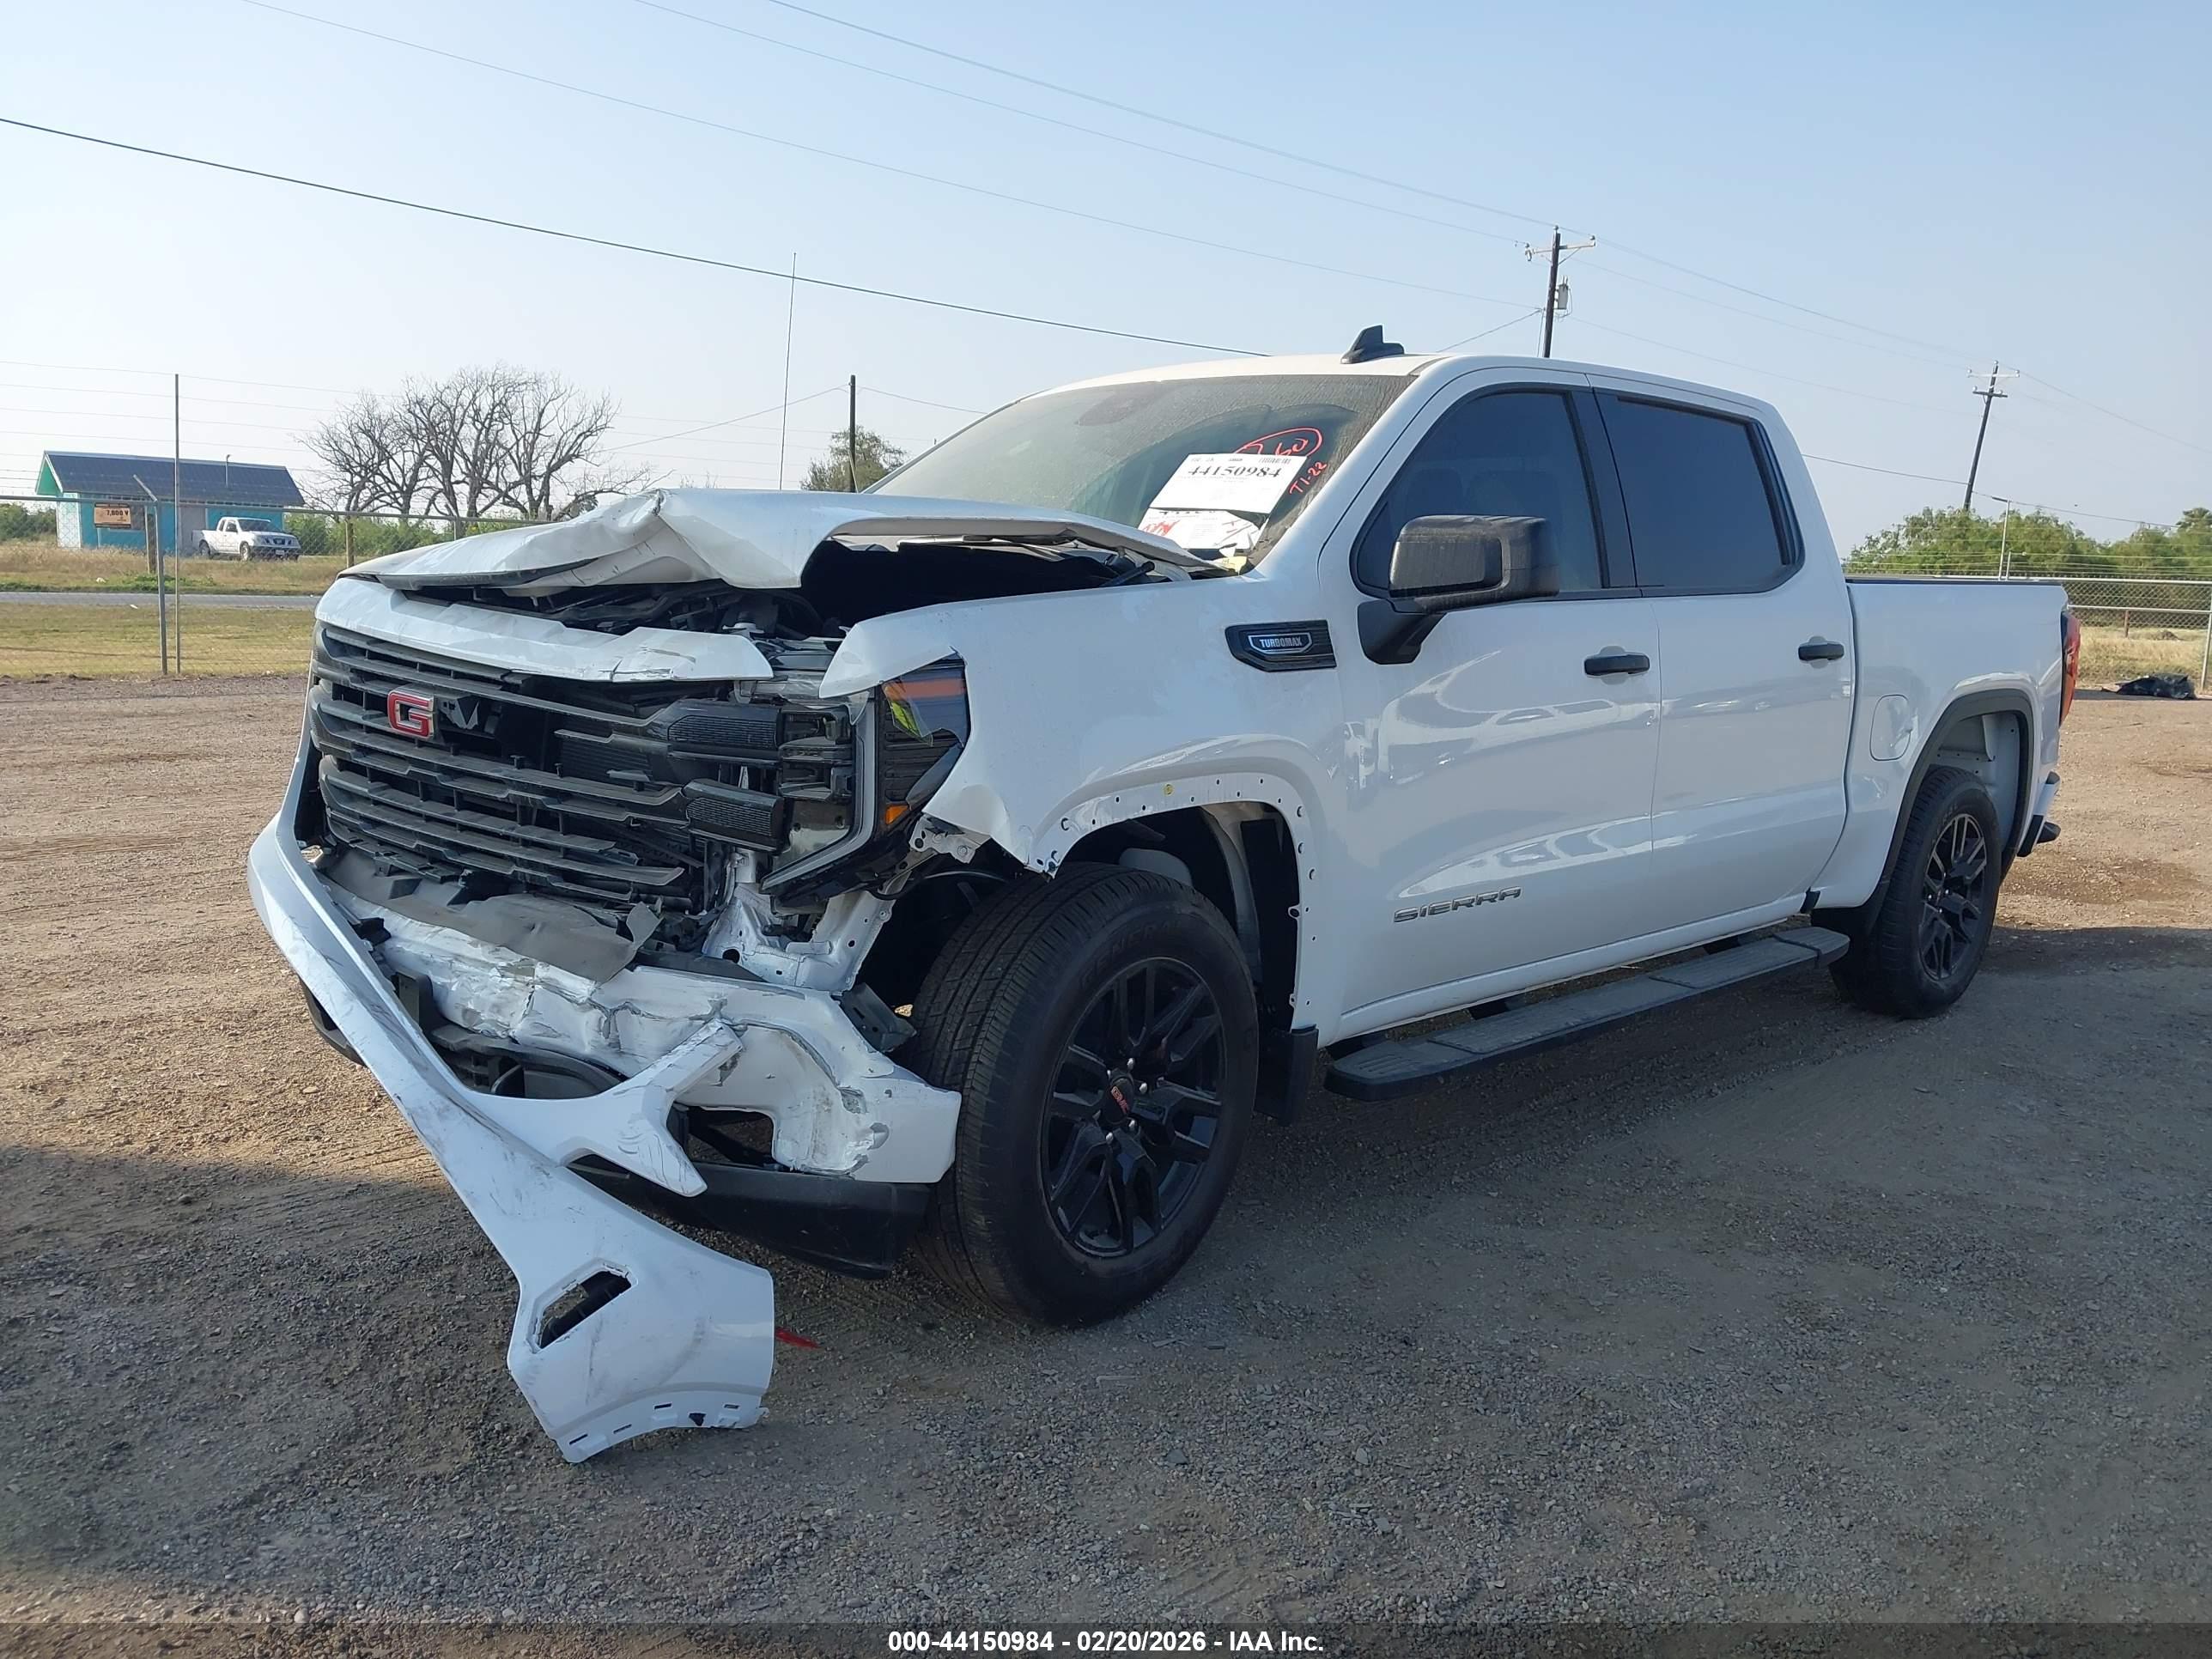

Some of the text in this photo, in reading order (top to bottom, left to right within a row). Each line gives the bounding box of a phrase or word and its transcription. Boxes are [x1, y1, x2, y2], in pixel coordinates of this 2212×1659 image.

[1188, 465, 1282, 477] 44150984
[1259, 636, 1303, 648] TURBOMAX
[1394, 885, 1522, 923] SIERRA
